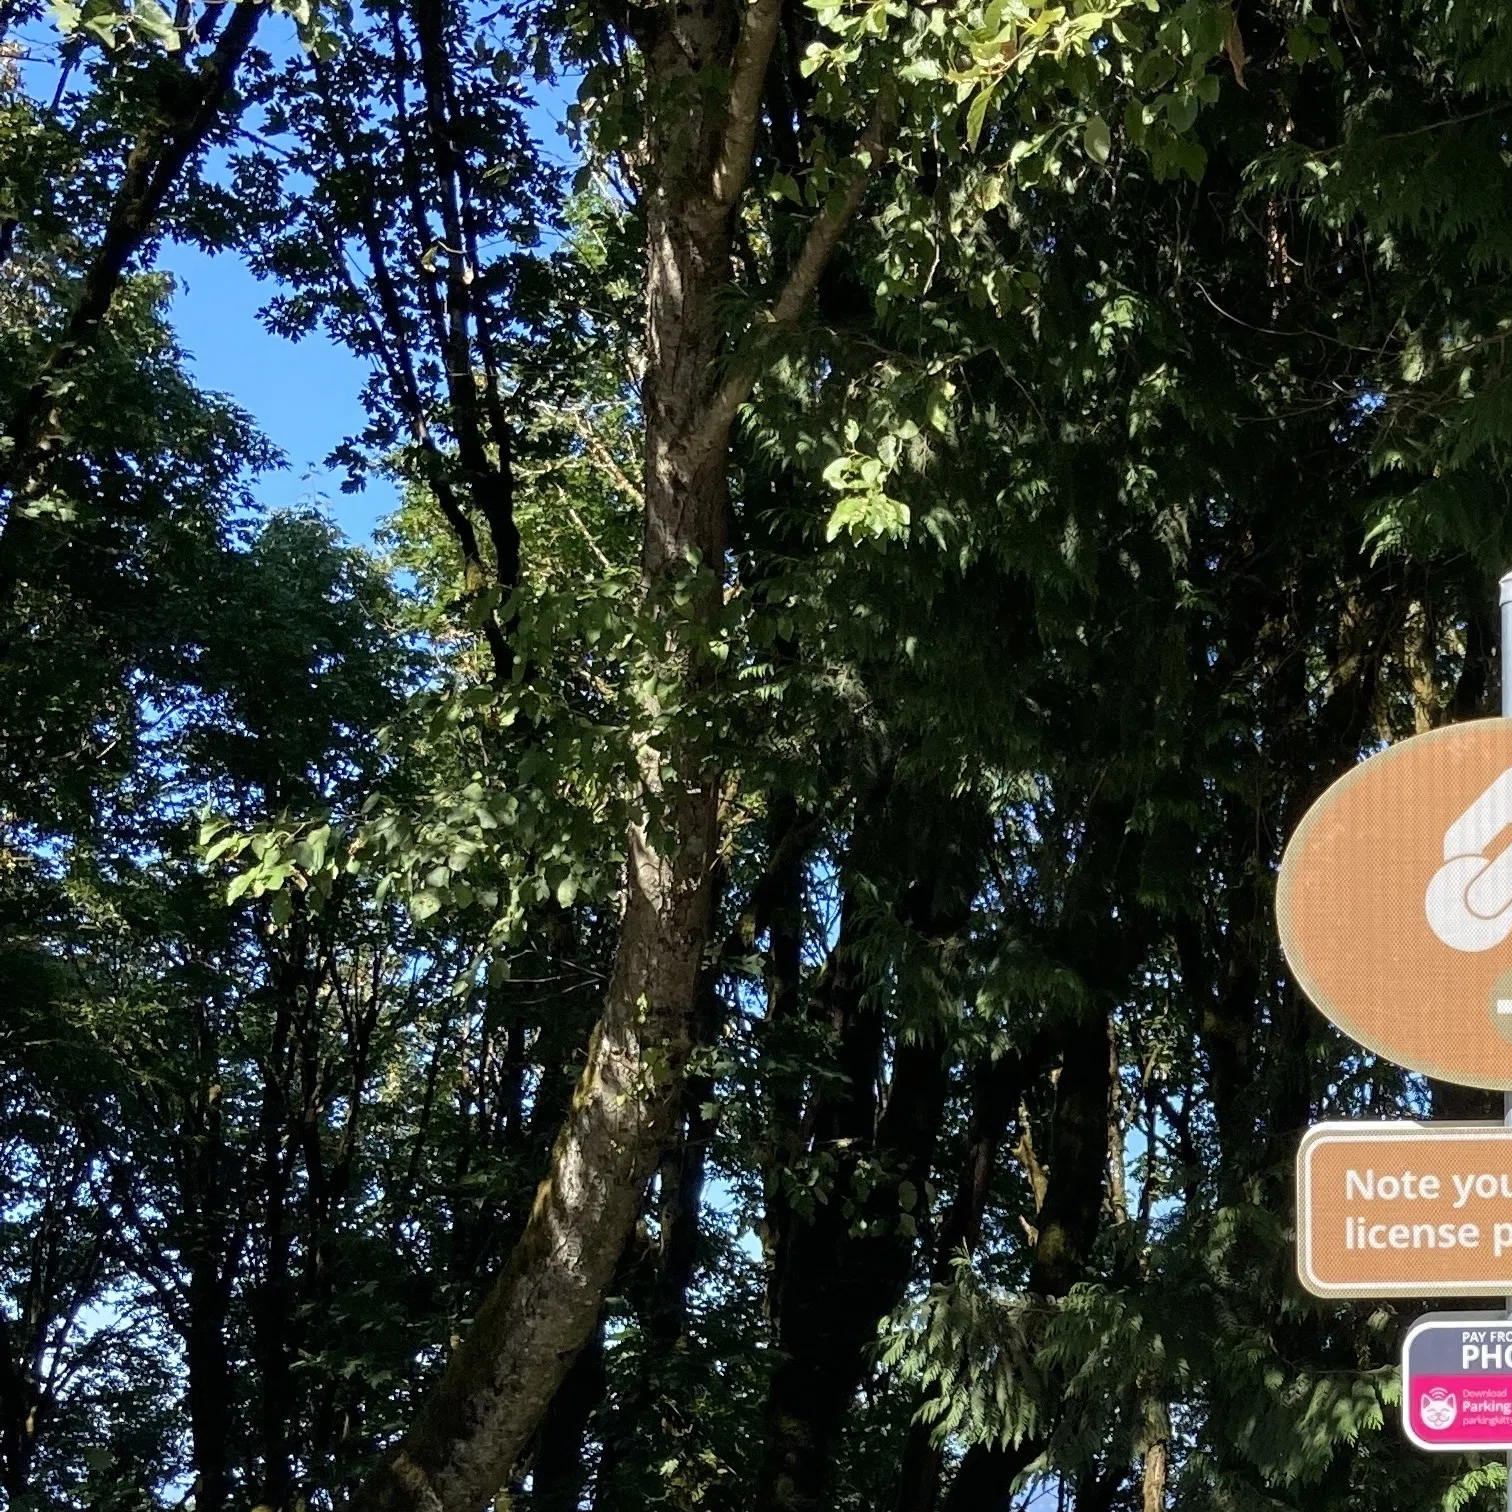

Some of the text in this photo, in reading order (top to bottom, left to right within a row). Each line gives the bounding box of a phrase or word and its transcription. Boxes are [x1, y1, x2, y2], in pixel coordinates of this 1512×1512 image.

[1345, 1168, 1441, 1200] Note
[1345, 1216, 1481, 1250] license
[1462, 1331, 1487, 1344] PAY
[1462, 1387, 1508, 1399] Download
[1462, 1399, 1512, 1416] Parking
